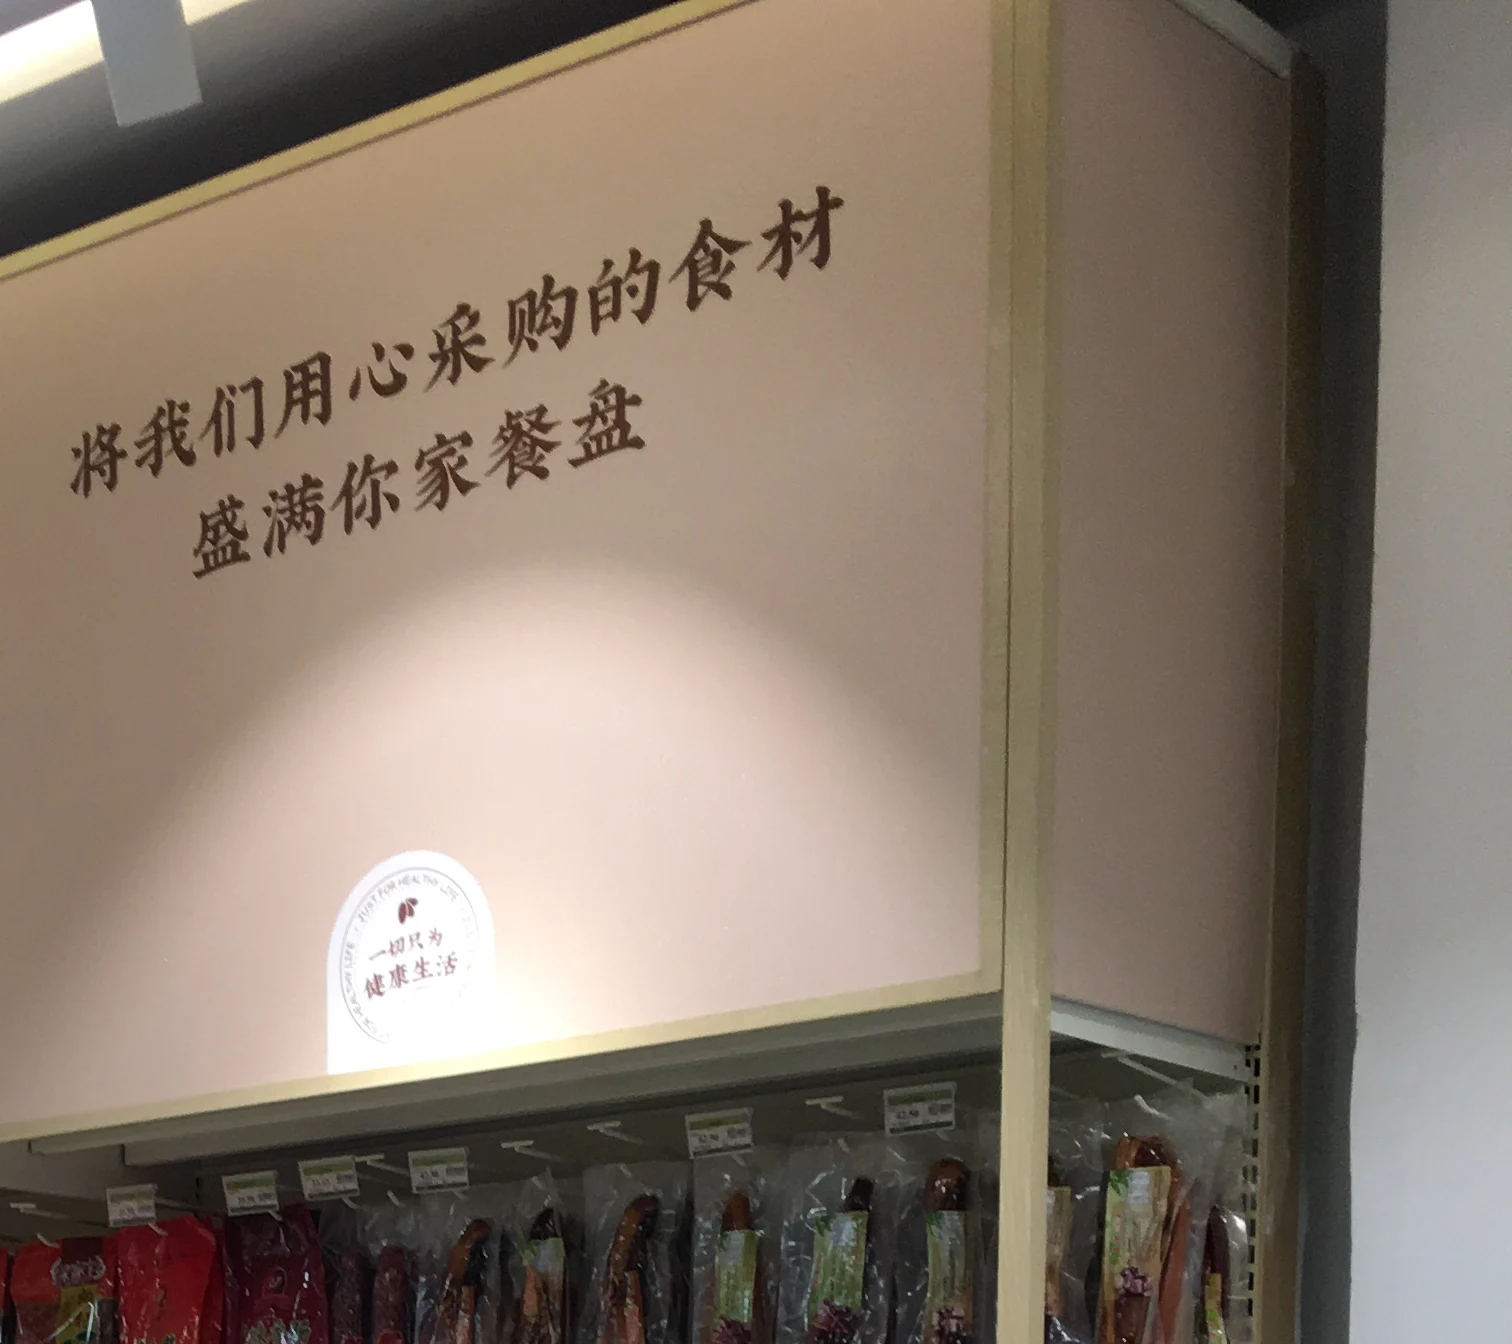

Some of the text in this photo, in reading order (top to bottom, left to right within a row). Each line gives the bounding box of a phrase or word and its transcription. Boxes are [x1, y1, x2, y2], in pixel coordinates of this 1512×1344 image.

[68, 186, 845, 498] 将我们用心采购的食材
[190, 379, 648, 579] 盛满你家餐盘
[364, 952, 458, 999] 健康生活
